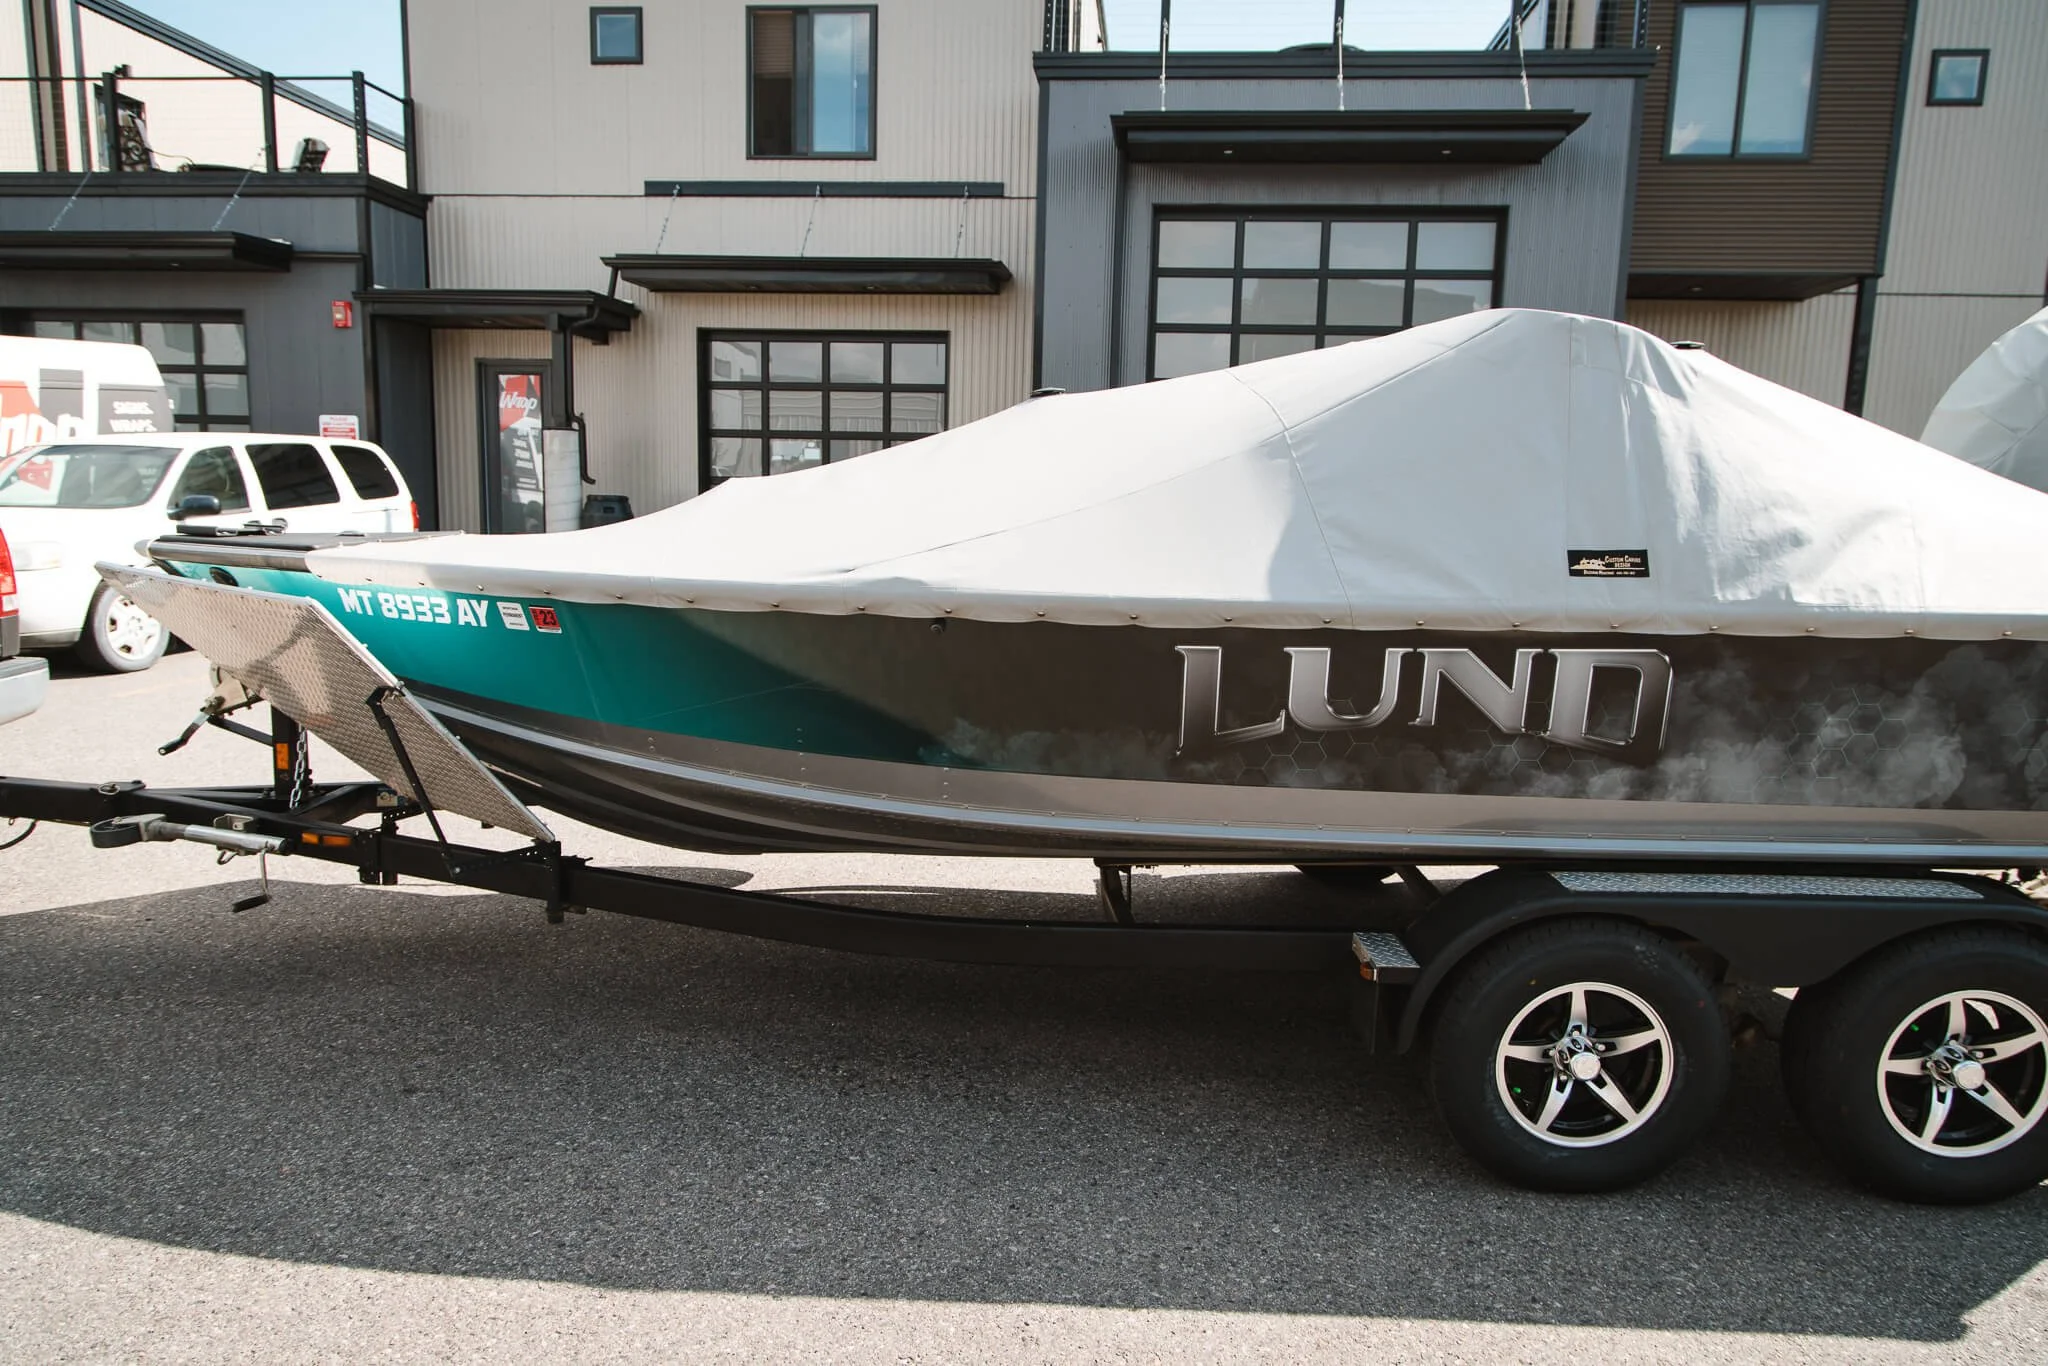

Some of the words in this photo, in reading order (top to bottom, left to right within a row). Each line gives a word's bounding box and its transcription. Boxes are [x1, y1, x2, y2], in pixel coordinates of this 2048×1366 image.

[499, 391, 538, 416] Wrap
[337, 587, 375, 616] MT
[377, 592, 452, 625] 8933
[456, 599, 489, 627] AY
[1174, 645, 1674, 760] LUND
